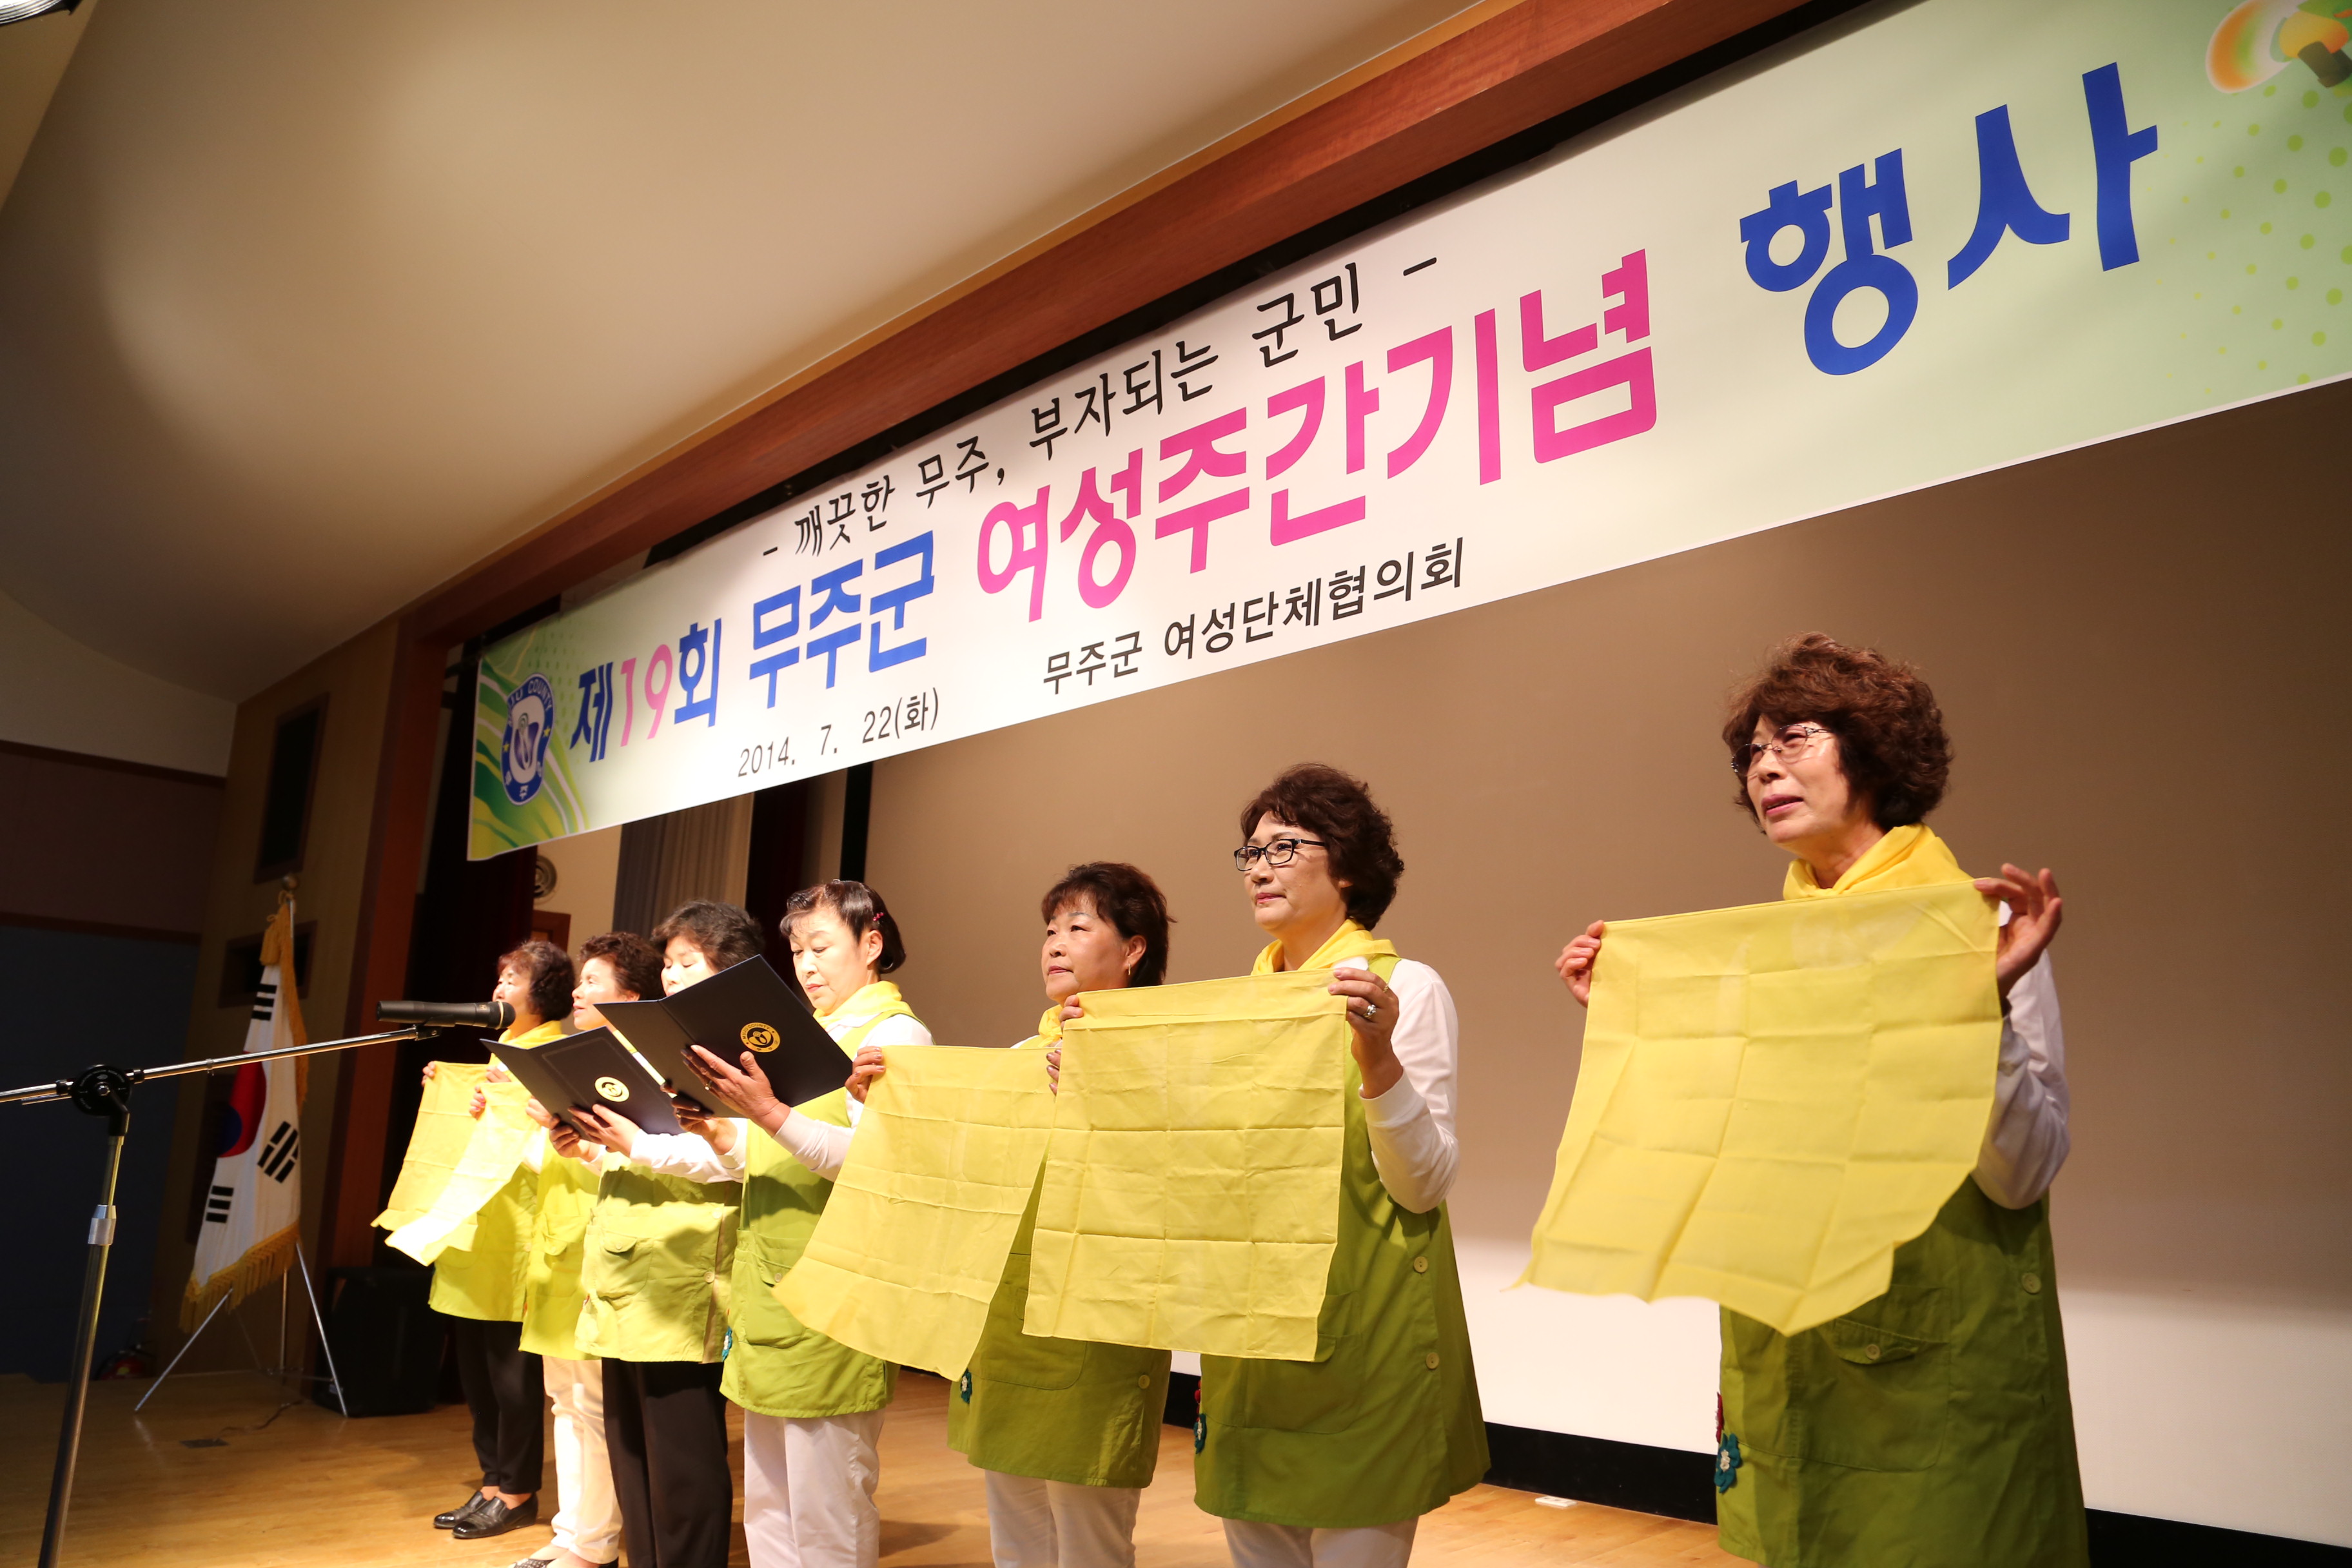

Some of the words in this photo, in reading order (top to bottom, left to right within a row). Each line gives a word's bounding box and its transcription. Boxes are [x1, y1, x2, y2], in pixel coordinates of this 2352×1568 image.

[569, 618, 721, 763] 제19회
[749, 530, 935, 709] 무주군
[977, 248, 1658, 623] 여성주간기념
[1740, 61, 2159, 376] 행사
[794, 475, 896, 556] 깨끗한
[916, 435, 1006, 509] 무주,
[1029, 340, 1219, 461] 부자되는
[1251, 262, 1363, 368] 군민
[1043, 631, 1144, 696] 무주군
[1163, 536, 1464, 660] 여성단체협의회
[738, 736, 796, 778] 2014.
[820, 724, 838, 755] 7.
[861, 687, 939, 745] 22(화)
